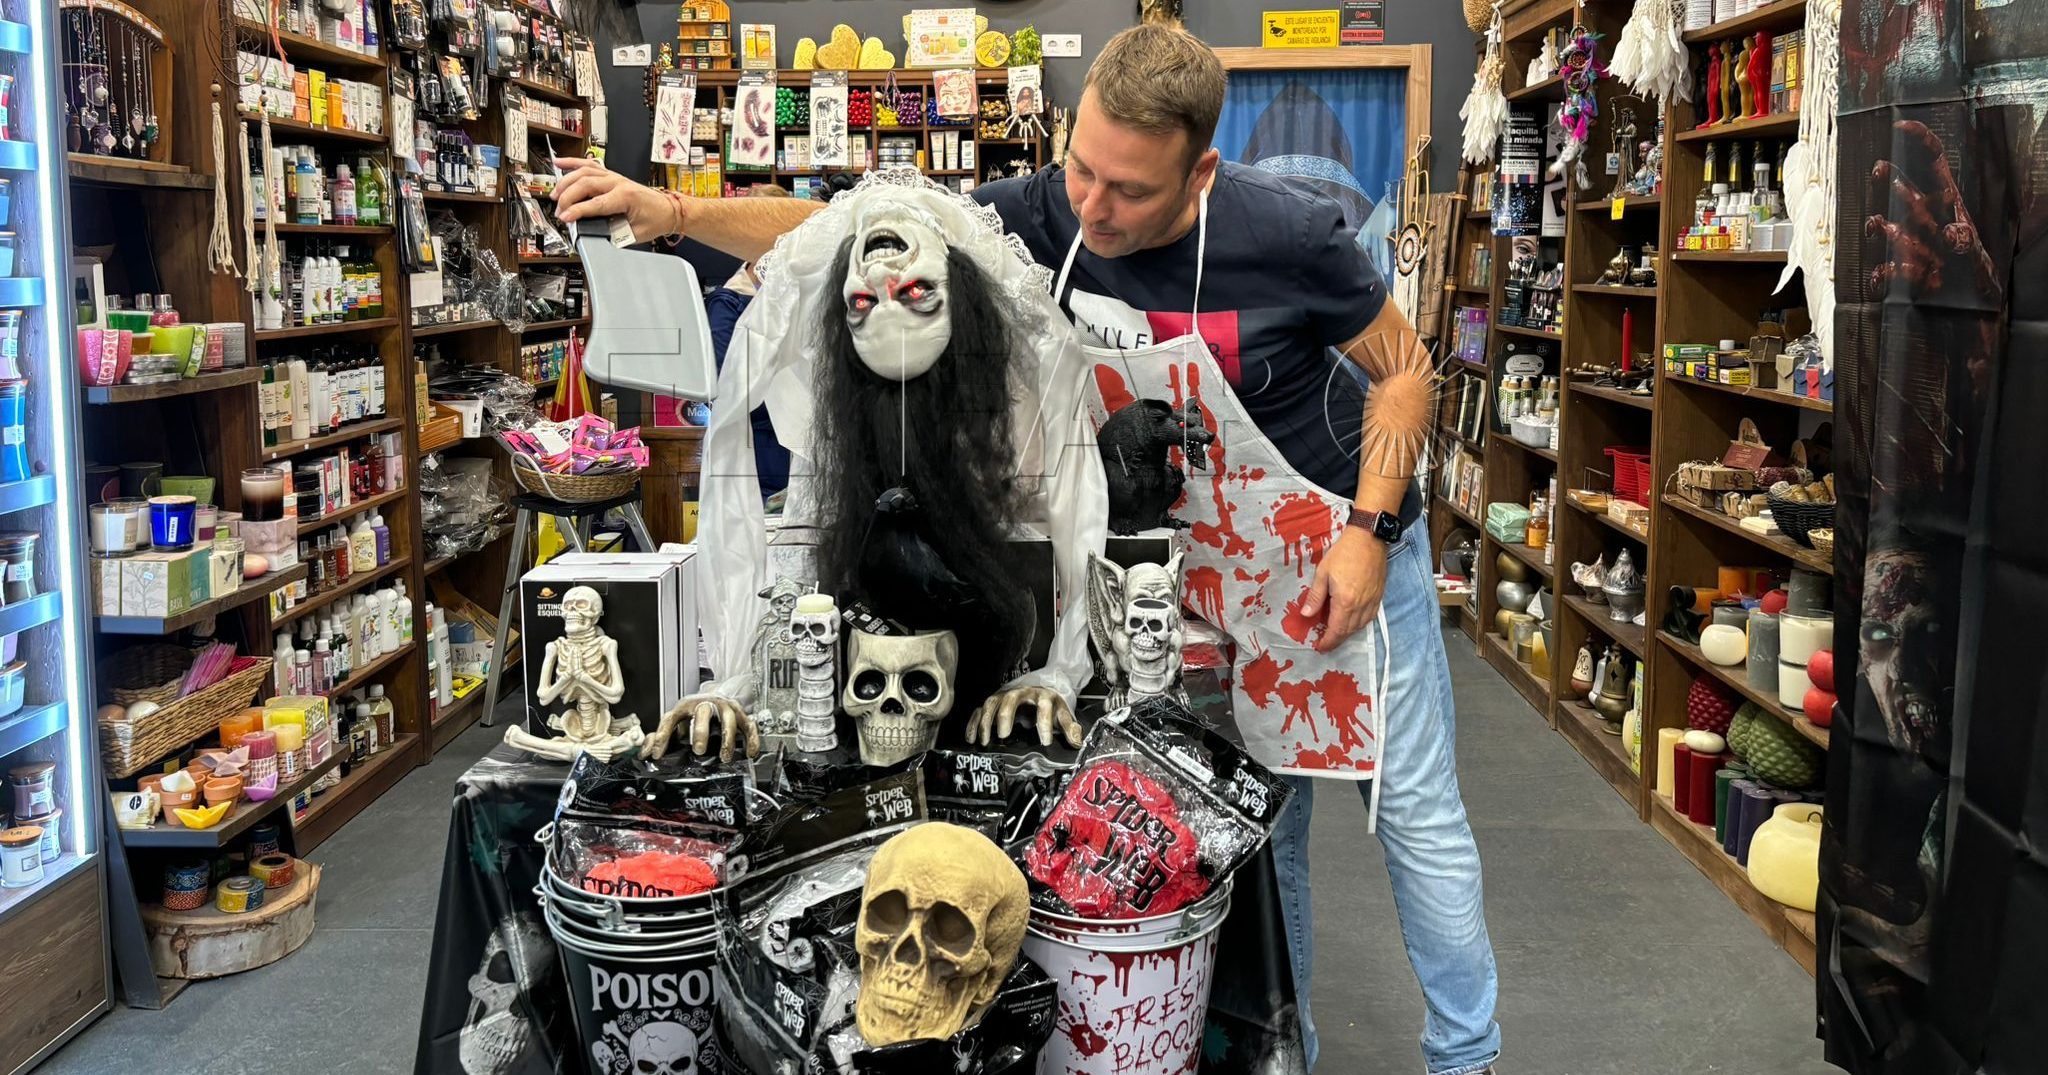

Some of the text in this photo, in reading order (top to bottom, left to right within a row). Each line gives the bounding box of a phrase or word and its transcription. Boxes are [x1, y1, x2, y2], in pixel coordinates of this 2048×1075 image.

[1514, 136, 1543, 144] mirada
[1111, 966, 1206, 1037] FRESH
[1110, 1004, 1204, 1074] BLOOD
